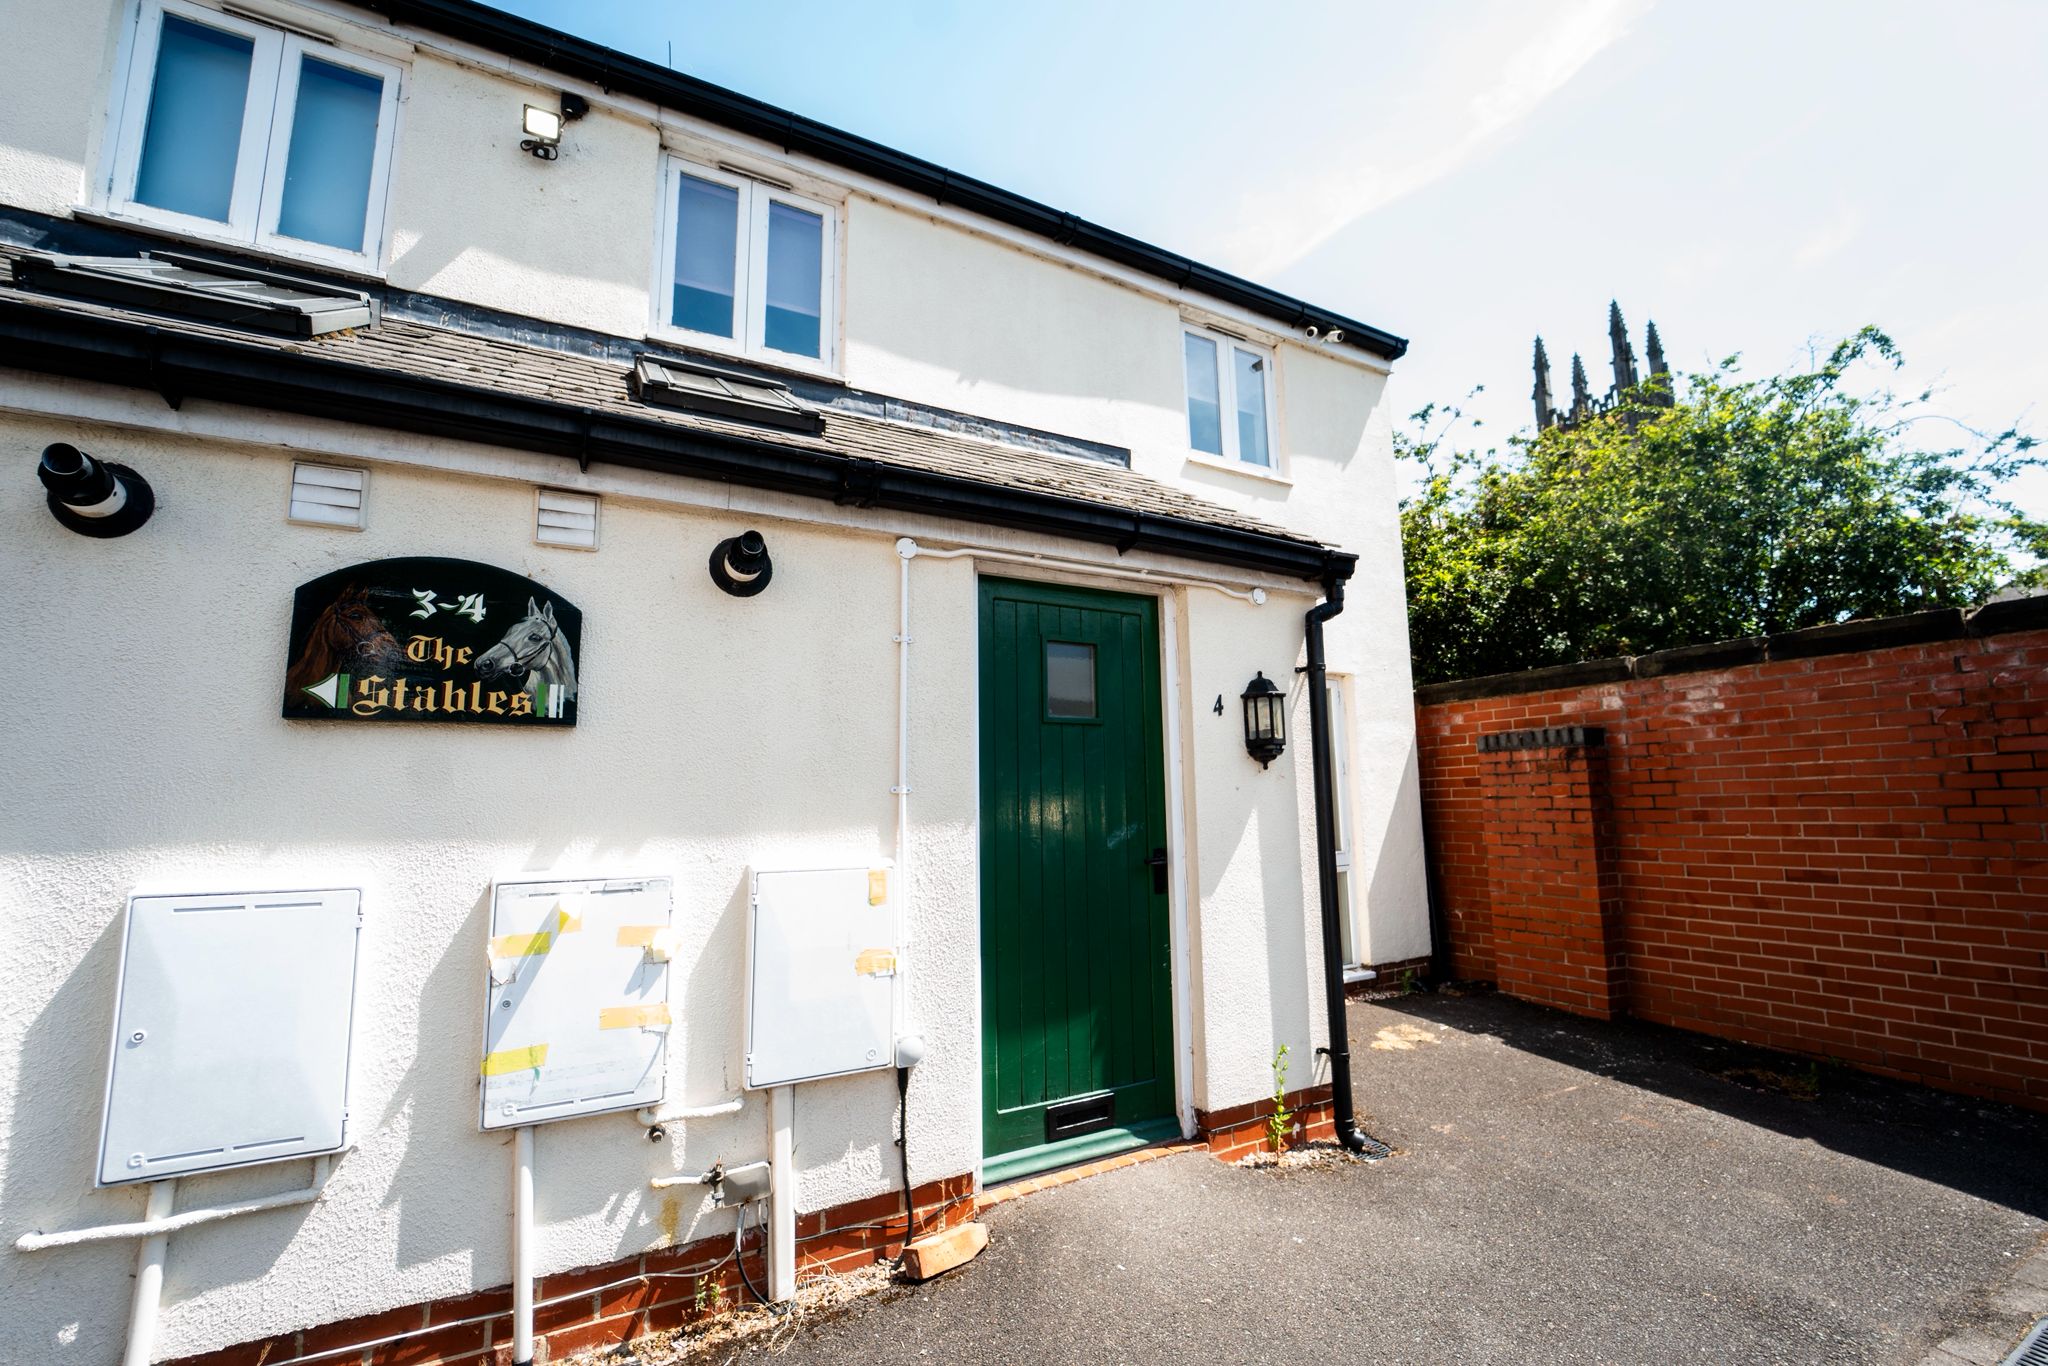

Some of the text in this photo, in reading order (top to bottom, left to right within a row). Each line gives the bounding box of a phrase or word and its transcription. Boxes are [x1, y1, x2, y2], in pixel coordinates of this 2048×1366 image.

[409, 587, 486, 624] 3-4
[407, 634, 475, 670] The
[352, 674, 533, 717] Stables
[1213, 694, 1224, 716] 4
